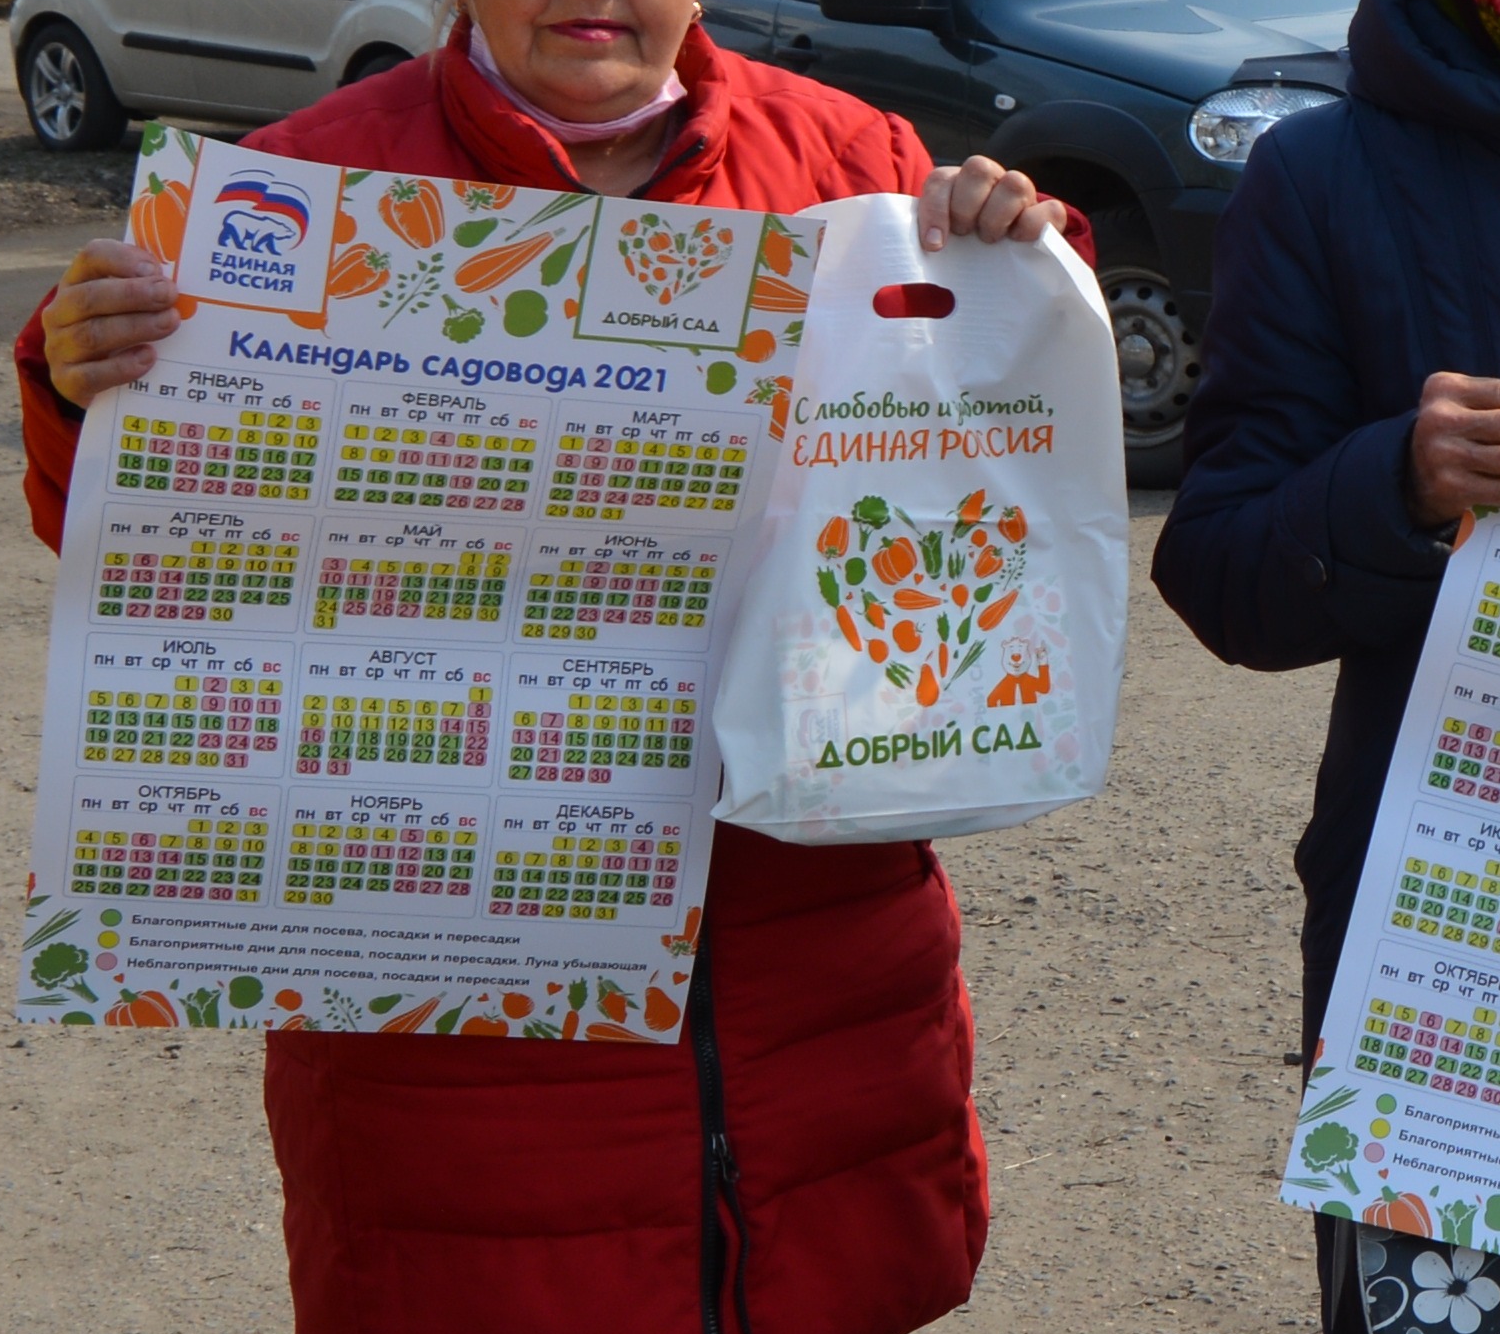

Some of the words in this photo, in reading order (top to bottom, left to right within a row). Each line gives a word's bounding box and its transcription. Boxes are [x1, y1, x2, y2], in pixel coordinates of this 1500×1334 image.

[210, 250, 296, 277] ЕДИНАЯ
[208, 268, 294, 294] РОССИЯ
[601, 310, 679, 330] ДОБРЫЙ
[681, 316, 720, 333] САД
[187, 370, 264, 392] ЯНВАРЬ
[592, 363, 667, 393] 2021
[401, 391, 487, 411] ФЕВРАЛЬ
[795, 396, 810, 425] С
[814, 391, 930, 421] любовью
[631, 409, 682, 427] МАРТ
[793, 428, 931, 468] ЕДИНАЯ
[169, 511, 245, 527] АПРЕЛЬ
[402, 523, 443, 537] МАЙ
[603, 534, 659, 549] ИЮНЬ
[162, 639, 217, 656] ИЮЛЬ
[368, 649, 438, 666] АВГУСТ
[562, 658, 654, 677] СЕНТЯБРЬ
[815, 720, 963, 768] ДОБРЫЙ
[971, 721, 1043, 753] САД
[137, 784, 222, 802] ОКТЯБРЬ
[350, 794, 424, 811] НОЯБРЬ
[555, 803, 635, 821] ДЕКАБРЬ
[131, 913, 248, 930] Благоприятные
[248, 922, 279, 932] дни
[280, 924, 310, 934] для
[312, 925, 367, 938] посева,
[370, 928, 430, 941] посадки
[433, 932, 443, 941] и
[445, 932, 521, 945] пересадки
